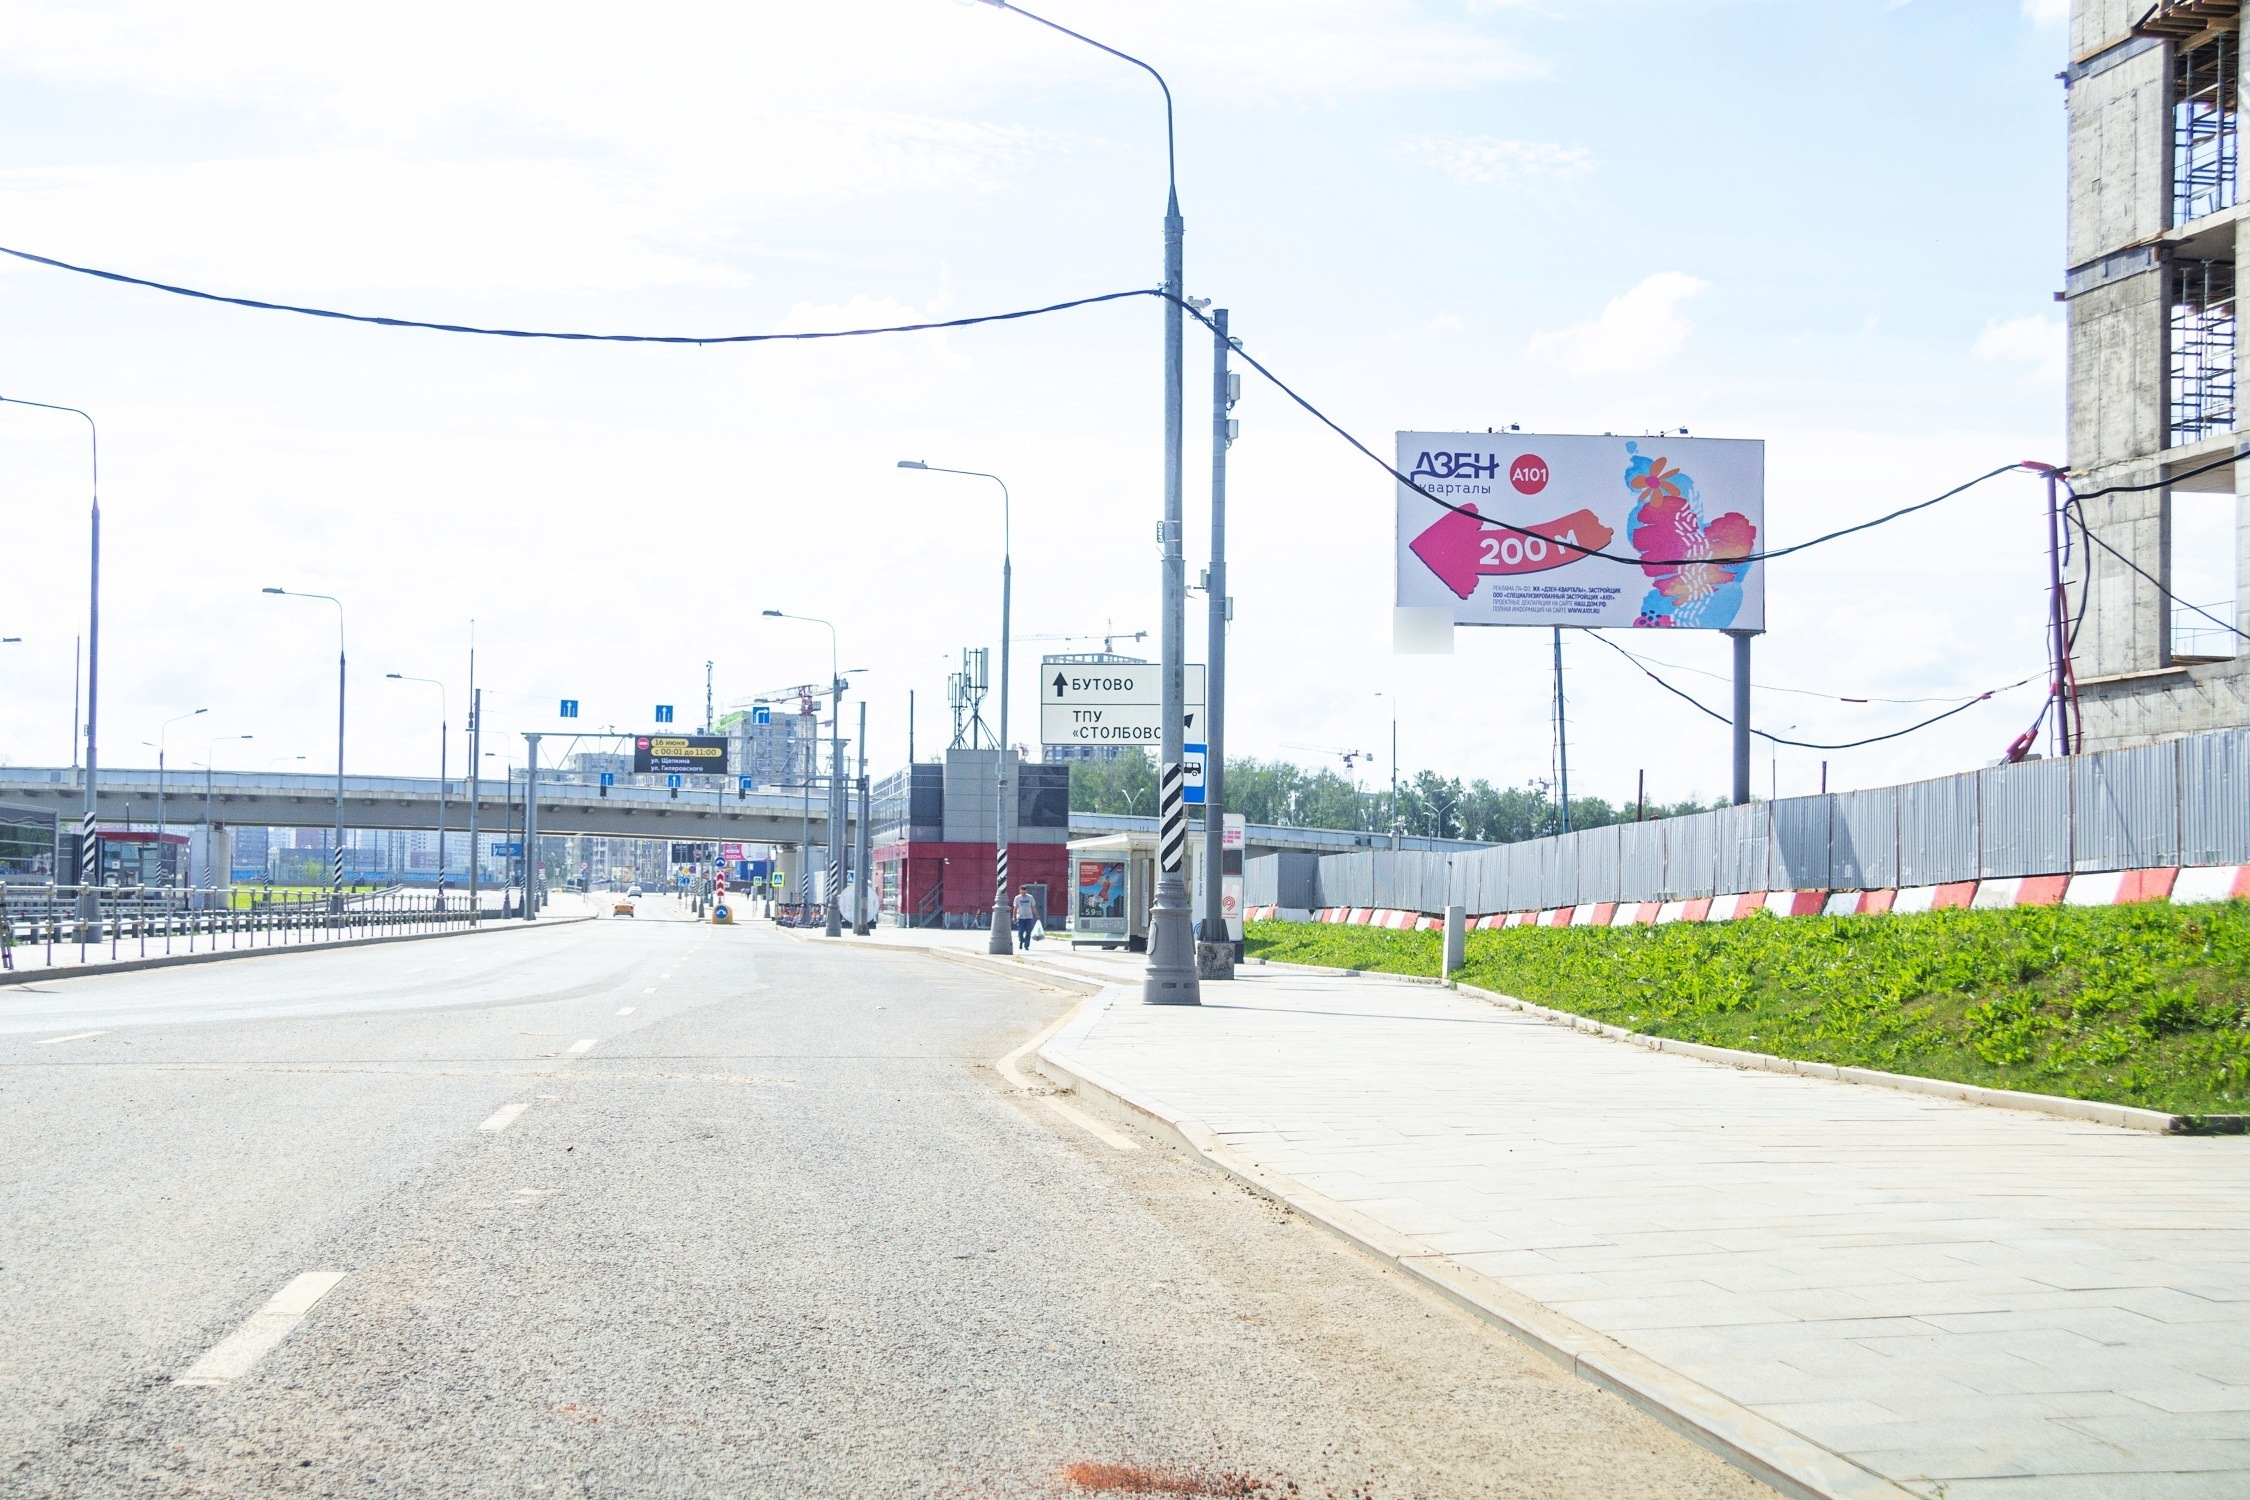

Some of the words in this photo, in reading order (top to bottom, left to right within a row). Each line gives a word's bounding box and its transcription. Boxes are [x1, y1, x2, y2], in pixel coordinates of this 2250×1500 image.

[1411, 451, 1499, 482] ДЗЕН
[1512, 467, 1547, 482] А101
[1419, 483, 1491, 496] кварталы
[1480, 536, 1547, 565] 200
[1072, 678, 1134, 691] БУТОВО
[1072, 710, 1103, 723] ТПУ
[1072, 726, 1161, 739] «СТОЛБОВО
